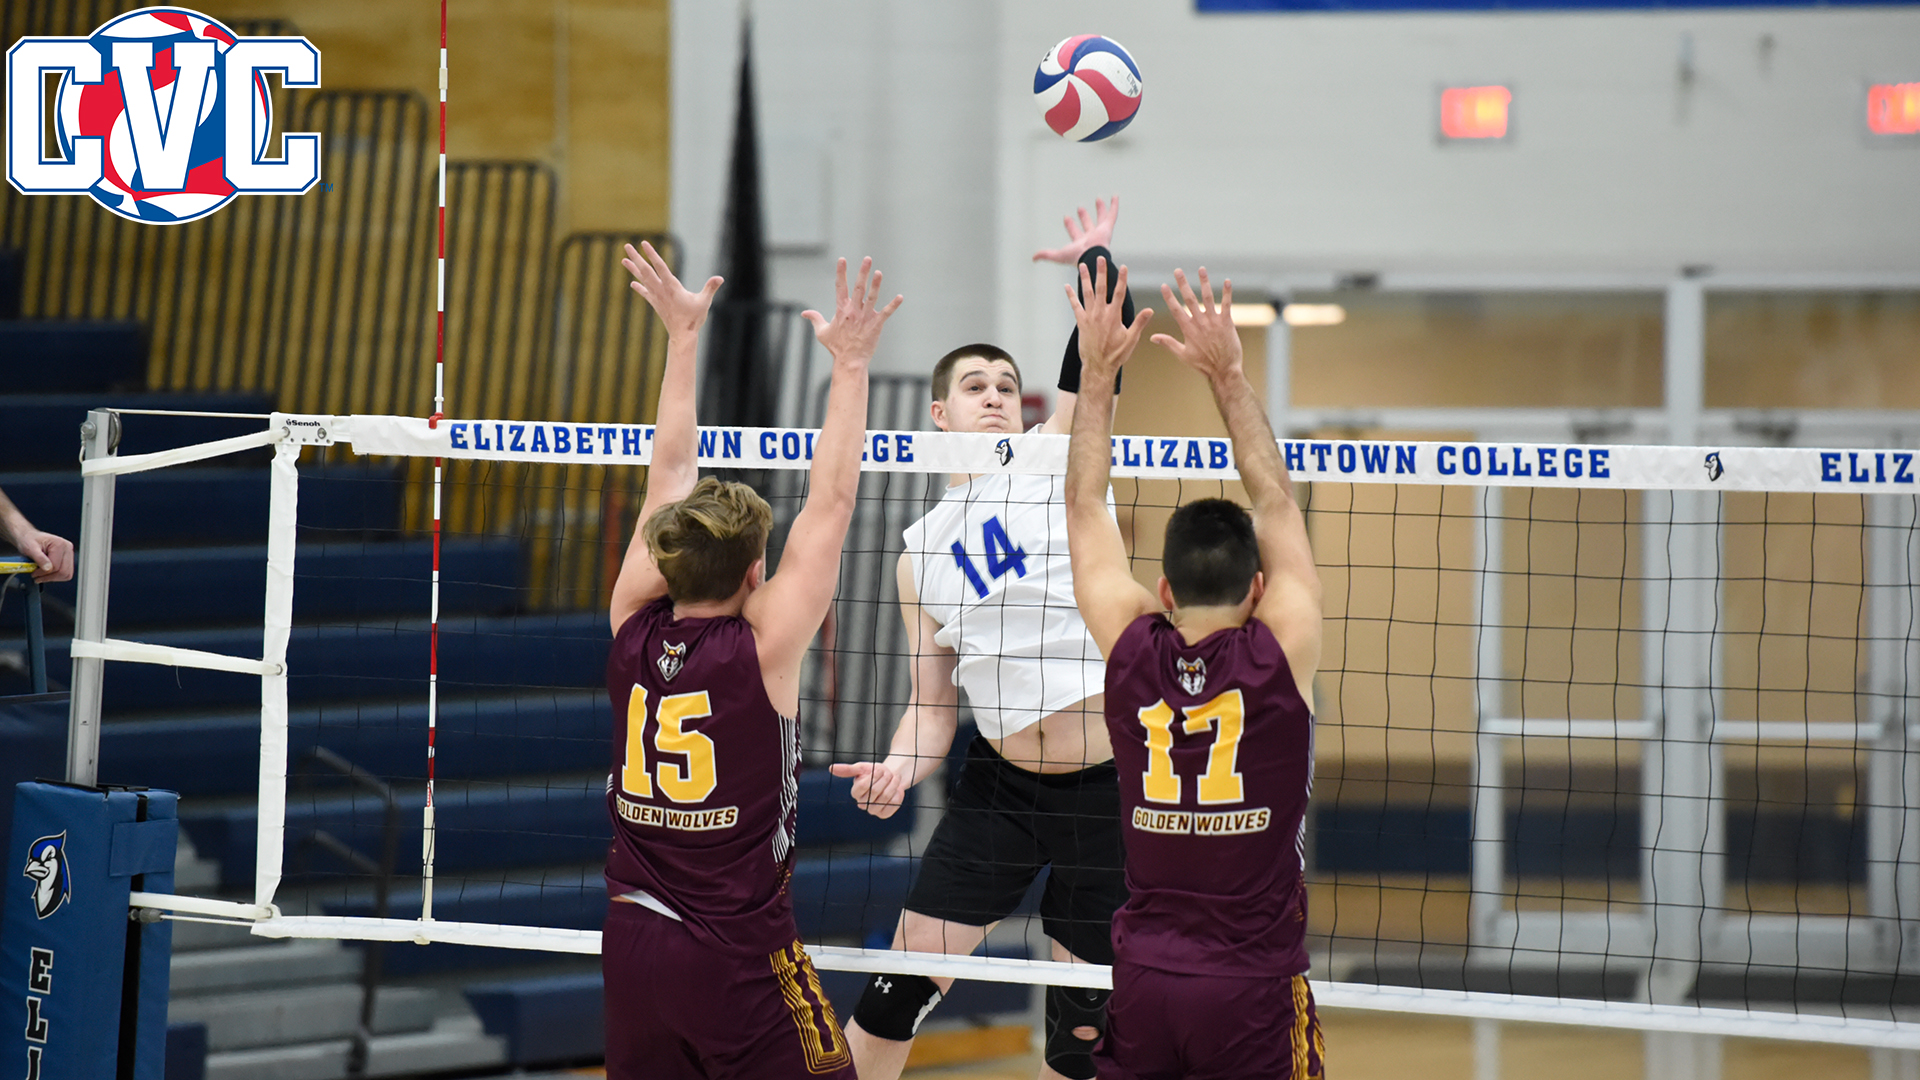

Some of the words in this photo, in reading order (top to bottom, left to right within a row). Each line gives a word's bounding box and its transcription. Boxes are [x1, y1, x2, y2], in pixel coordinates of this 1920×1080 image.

[291, 419, 321, 427] Senoh
[450, 422, 742, 459] ELIZABETHWN
[760, 431, 914, 463] COLGE
[1111, 438, 1417, 475] LIZABHTOWN
[1437, 445, 1611, 479] COLLEGE
[951, 513, 1028, 600] 14
[622, 683, 717, 803] 15
[1138, 688, 1245, 805] 17
[667, 807, 737, 829] WOLVES
[1133, 808, 1190, 832] GOLDEN
[1195, 809, 1269, 832] WOLVES
